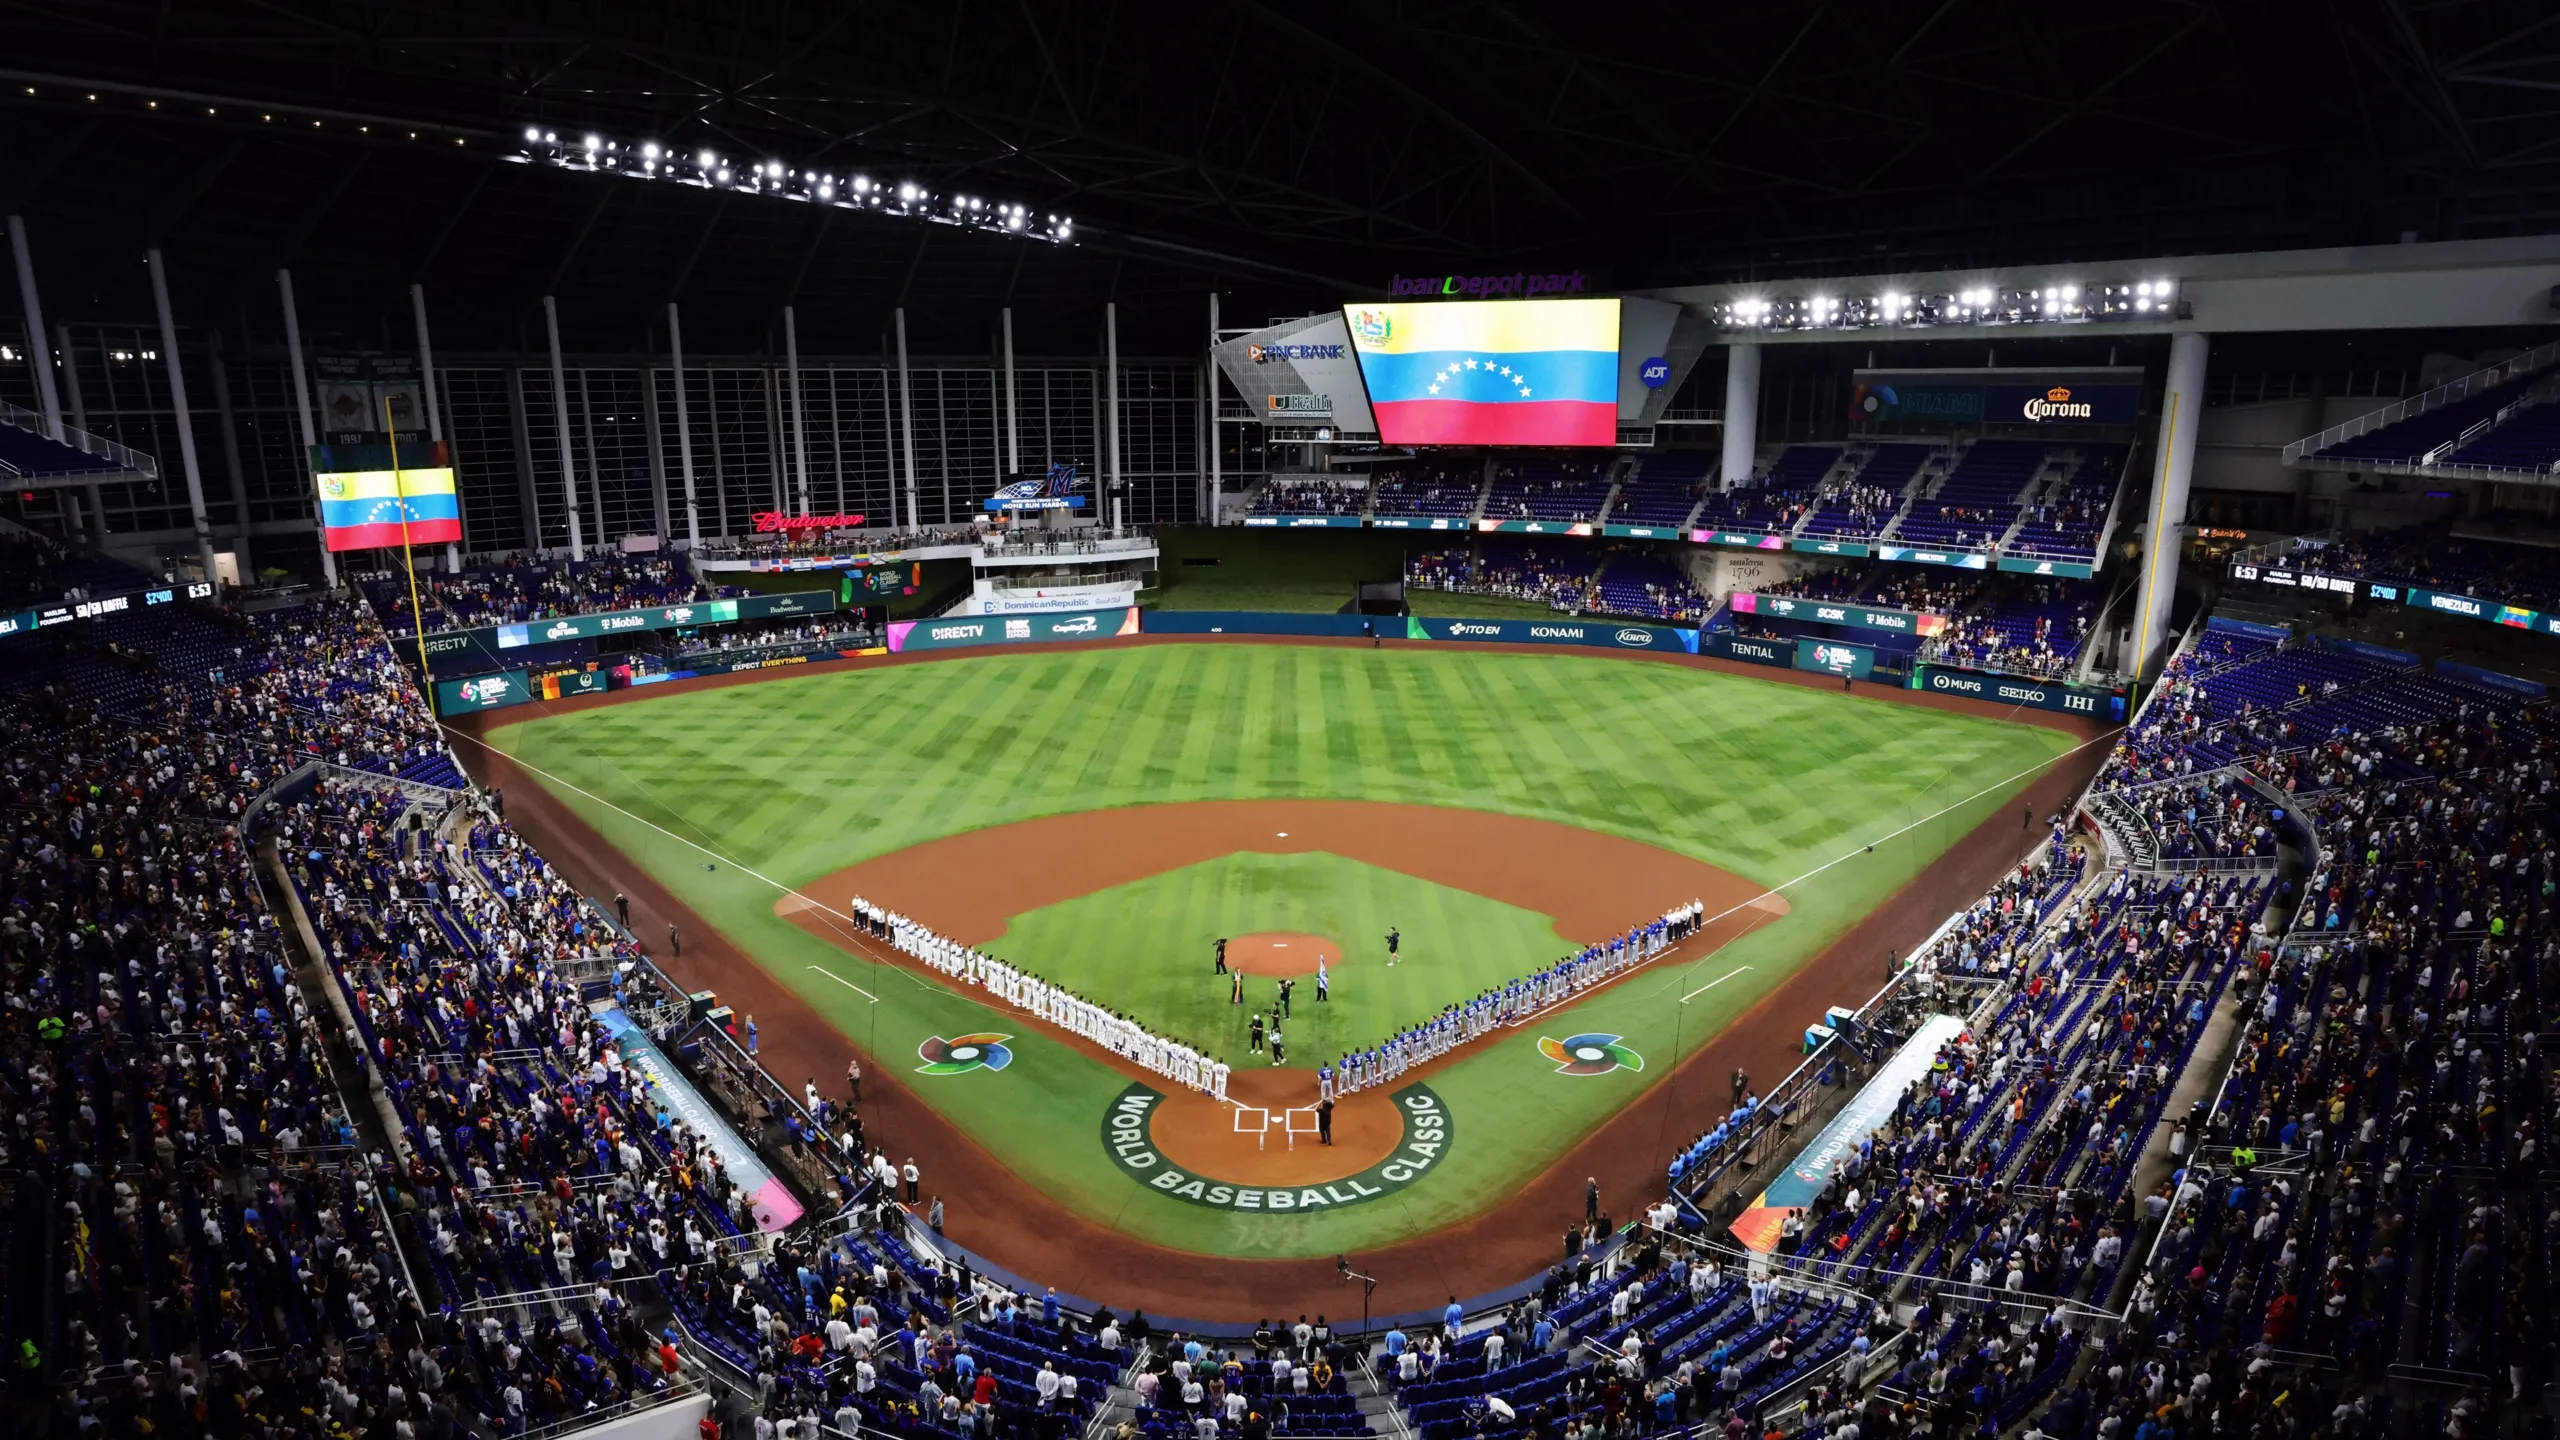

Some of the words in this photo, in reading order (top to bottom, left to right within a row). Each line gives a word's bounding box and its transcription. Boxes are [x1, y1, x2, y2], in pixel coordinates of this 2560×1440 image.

[1392, 271, 1523, 298] loanDepot
[1526, 269, 1586, 299] park
[1265, 344, 1300, 359] PNC
[1300, 344, 1344, 360] BANK
[1643, 366, 1667, 378] ADT
[1902, 392, 1978, 415] MIAMI
[2023, 398, 2092, 422] Corona
[752, 510, 865, 532] Budweiser
[1732, 567, 1760, 579] 1796
[2235, 566, 2258, 580] 6:53
[2270, 570, 2292, 579] MARLINS
[2263, 577, 2296, 586] FOUNDATION
[2301, 575, 2328, 589] 50/50
[2329, 578, 2356, 594] RAFFLE
[145, 590, 173, 605] $2400
[188, 583, 211, 598] 6:53
[2370, 585, 2397, 600] $2400
[75, 601, 102, 618] 50/50
[102, 597, 129, 613] RAFFLE
[770, 603, 804, 614] Budweiser
[1004, 600, 1050, 610] Dominican
[1051, 598, 1089, 610] Republic
[2431, 595, 2480, 616] VENEZUELA
[39, 615, 73, 627] FOUNDATION
[1817, 608, 1845, 621] SCSK
[1875, 615, 1906, 628] Mobile
[612, 616, 644, 629] Mobile
[1465, 624, 1484, 635] ITO
[1484, 625, 1501, 635] EN
[547, 626, 579, 640] Corona
[932, 625, 984, 640] DIRECTV
[1530, 626, 1584, 639] KONAMI
[1617, 630, 1651, 643] Kowa
[1731, 643, 1774, 660] TENTIAL
[732, 661, 760, 672] EXPECT
[761, 656, 807, 668] EVERYTHING
[1950, 679, 1981, 692] MUFG
[1999, 686, 2045, 702] SEIKO
[2064, 694, 2094, 711] IHI
[637, 1055, 664, 1081] WORLD
[658, 1077, 692, 1112] BASEBALL
[685, 1110, 718, 1140] CLASSIC
[1809, 1137, 1844, 1170] WORLD
[1836, 1105, 1874, 1144] BASEBALL
[1111, 1094, 1157, 1169] WORLD
[1150, 1170, 1382, 1209] BASEBALL
[1382, 1094, 1444, 1182] CLASSIC
[1226, 1369, 1236, 1377] 24
